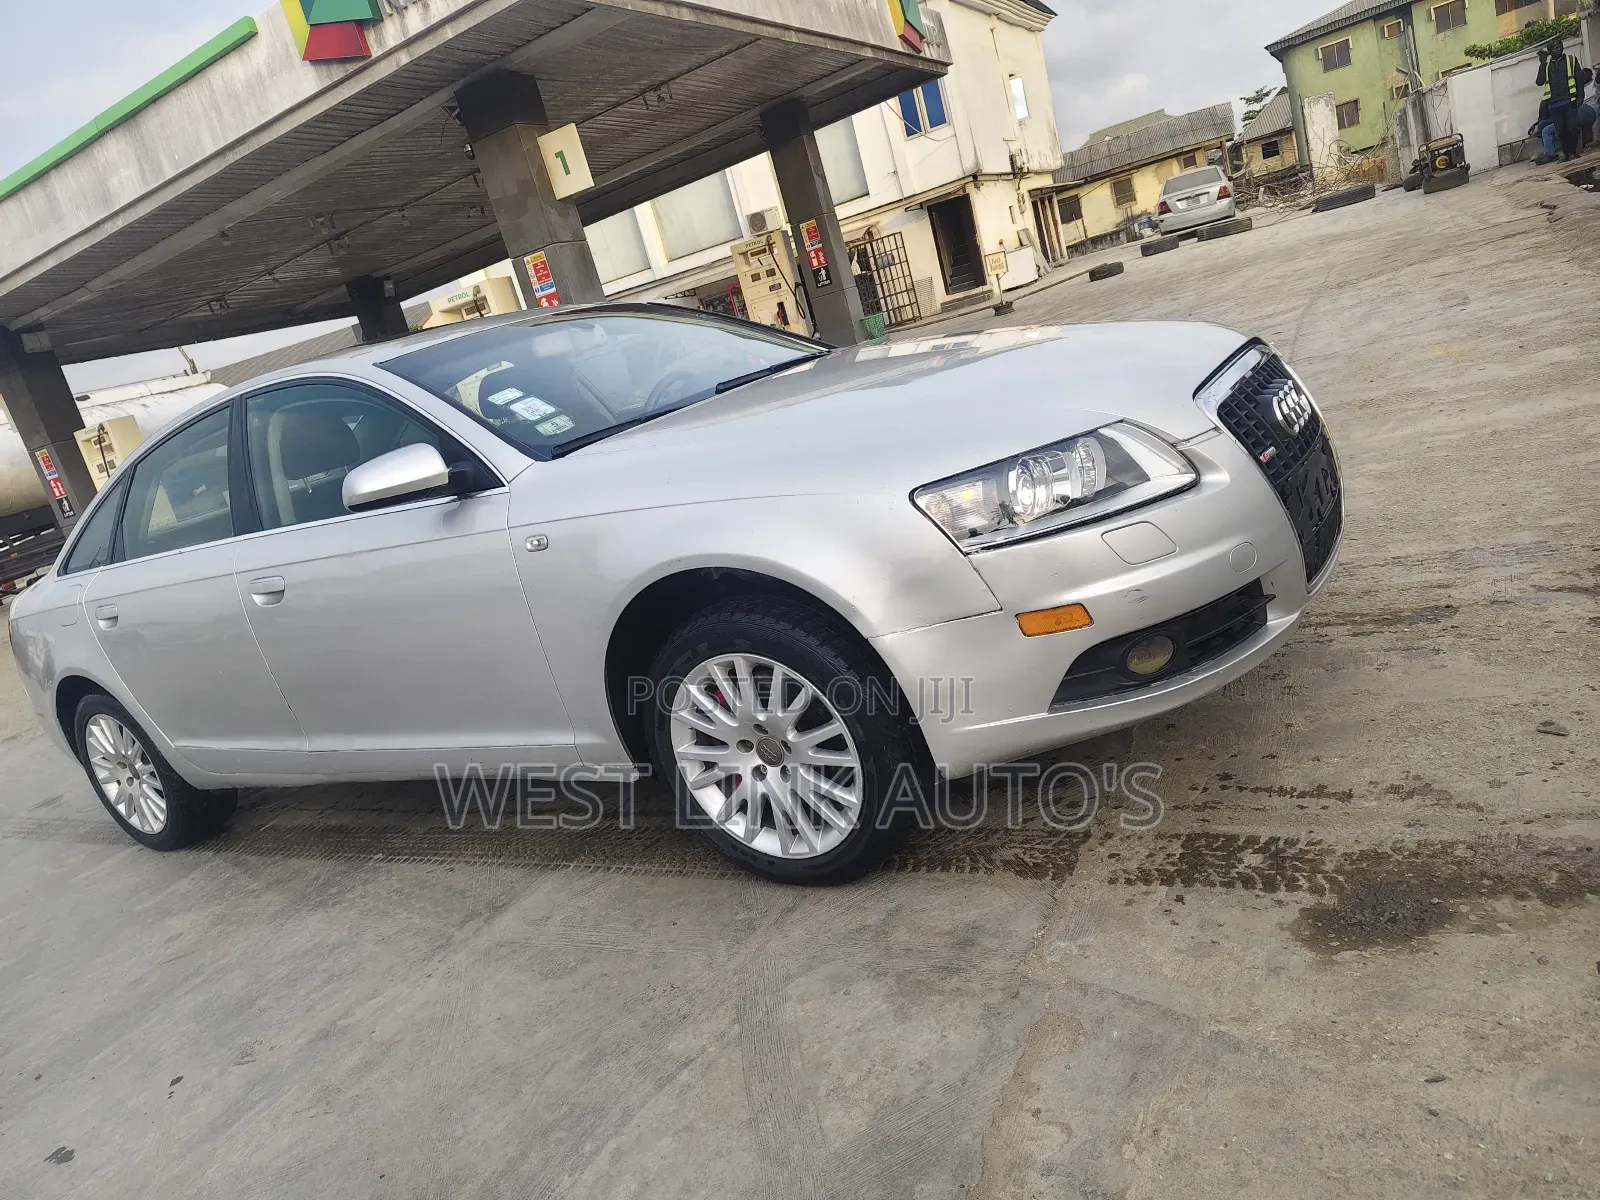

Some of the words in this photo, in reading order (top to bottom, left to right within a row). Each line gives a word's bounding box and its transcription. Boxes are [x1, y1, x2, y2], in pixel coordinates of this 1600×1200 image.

[554, 149, 571, 176] 1
[744, 240, 763, 249] PETROL
[447, 291, 471, 304] PETROL
